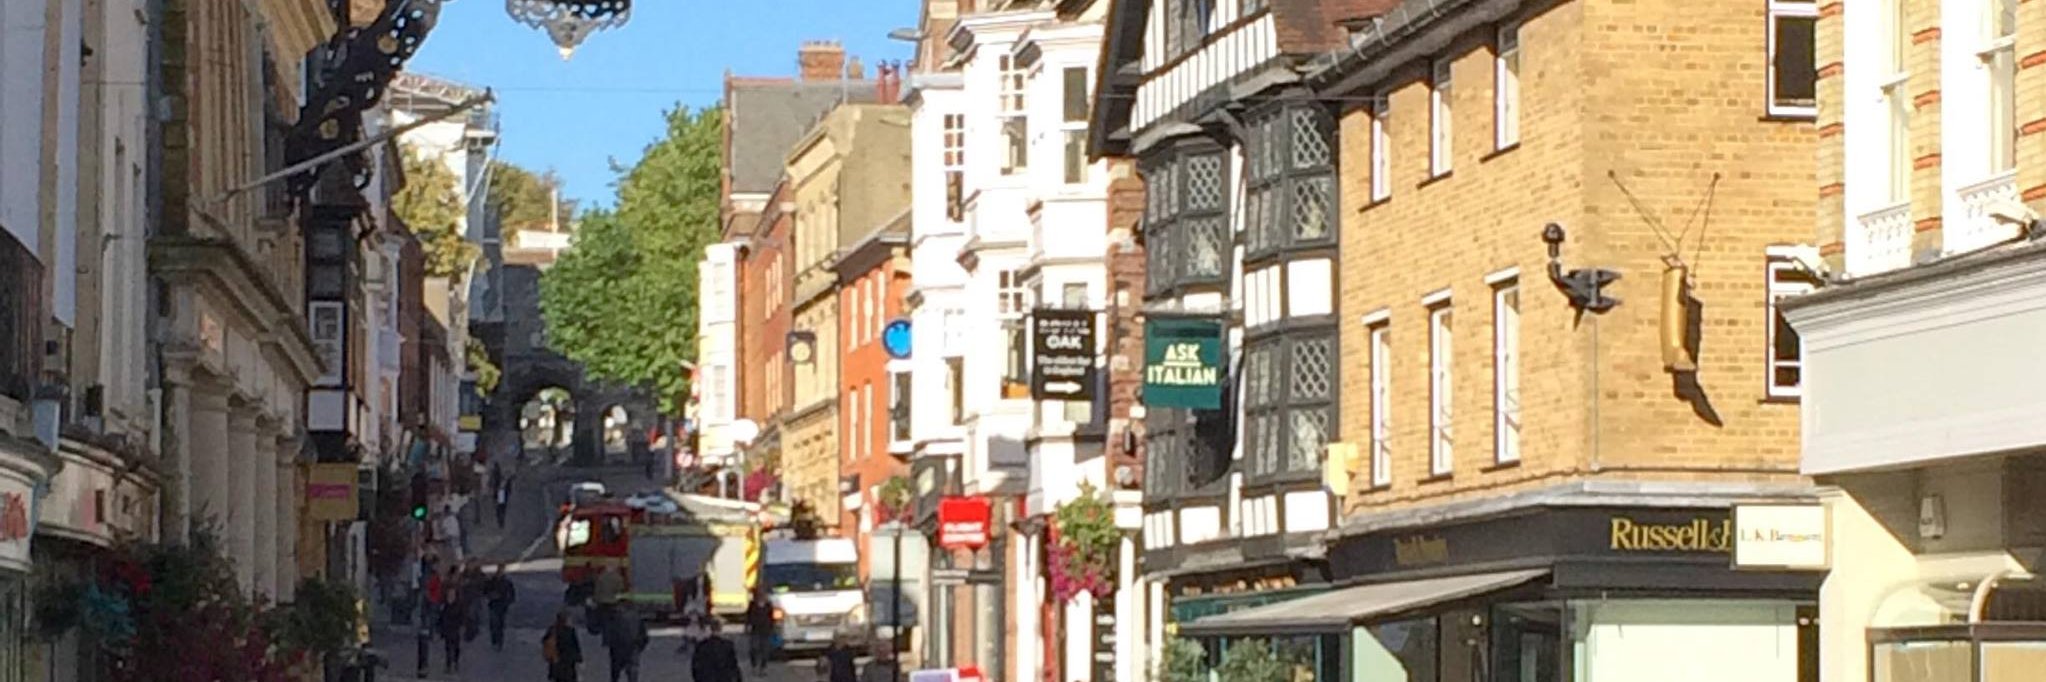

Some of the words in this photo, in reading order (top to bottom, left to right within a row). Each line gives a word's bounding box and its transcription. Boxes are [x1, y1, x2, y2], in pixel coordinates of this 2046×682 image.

[1045, 335, 1082, 350] OAK
[1164, 343, 1200, 361] ASK
[1147, 365, 1217, 386] ITALIAN
